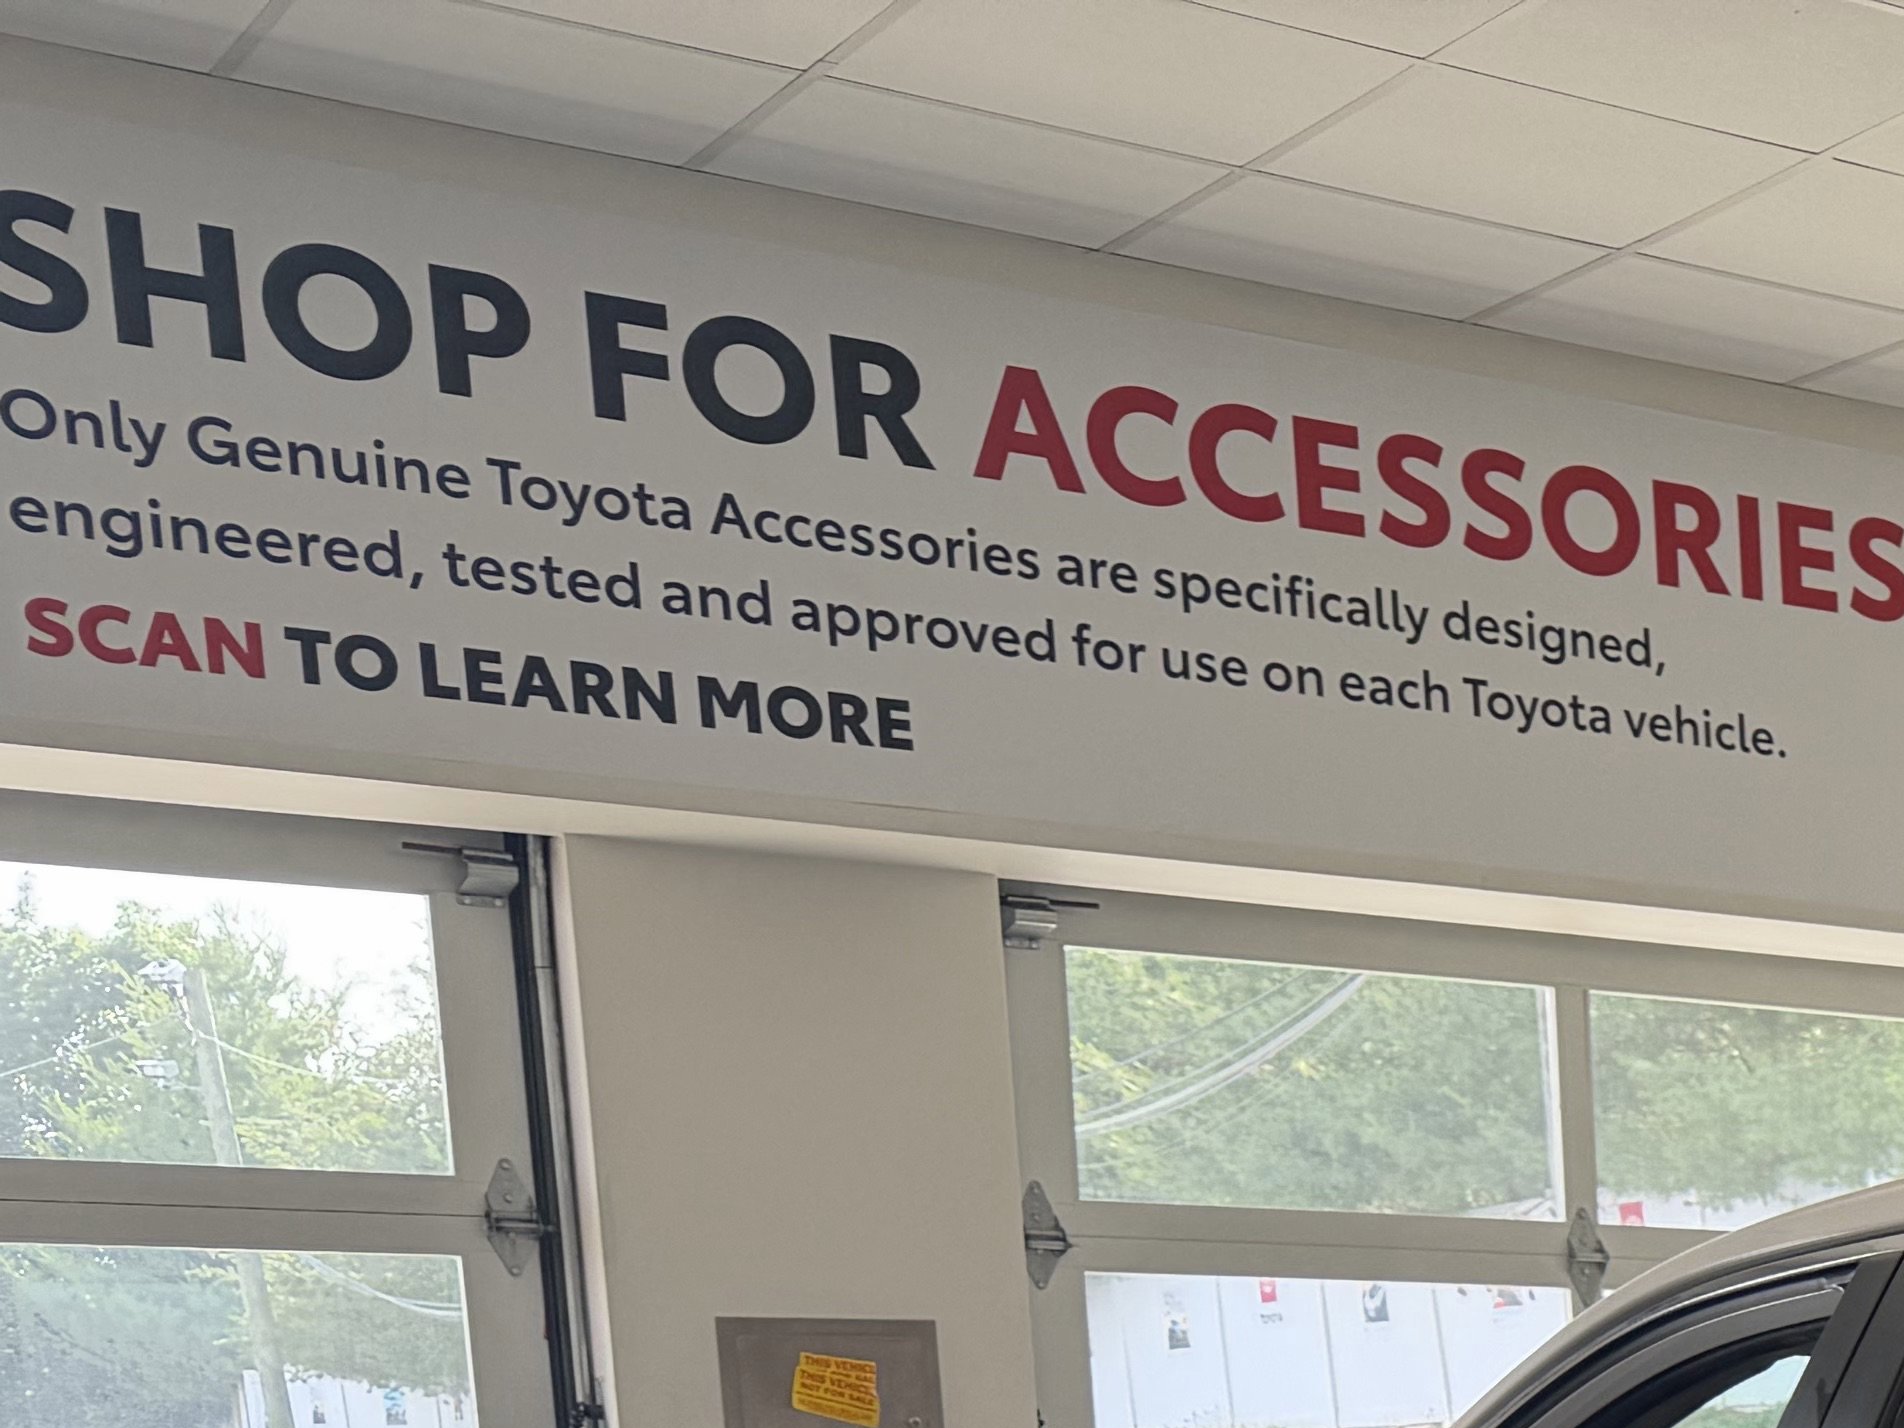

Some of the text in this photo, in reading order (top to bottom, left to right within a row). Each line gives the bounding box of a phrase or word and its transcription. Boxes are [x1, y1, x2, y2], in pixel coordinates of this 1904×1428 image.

[0, 187, 531, 398] SHOP
[584, 290, 936, 471] FOR
[1, 388, 1667, 676] Only Genuine Toyota Accessories are specifically designed,
[9, 495, 1788, 760] engineered, tested and approved for use on each Toyota vehicle.
[25, 596, 914, 752] SCAN TO LEARN MORE
